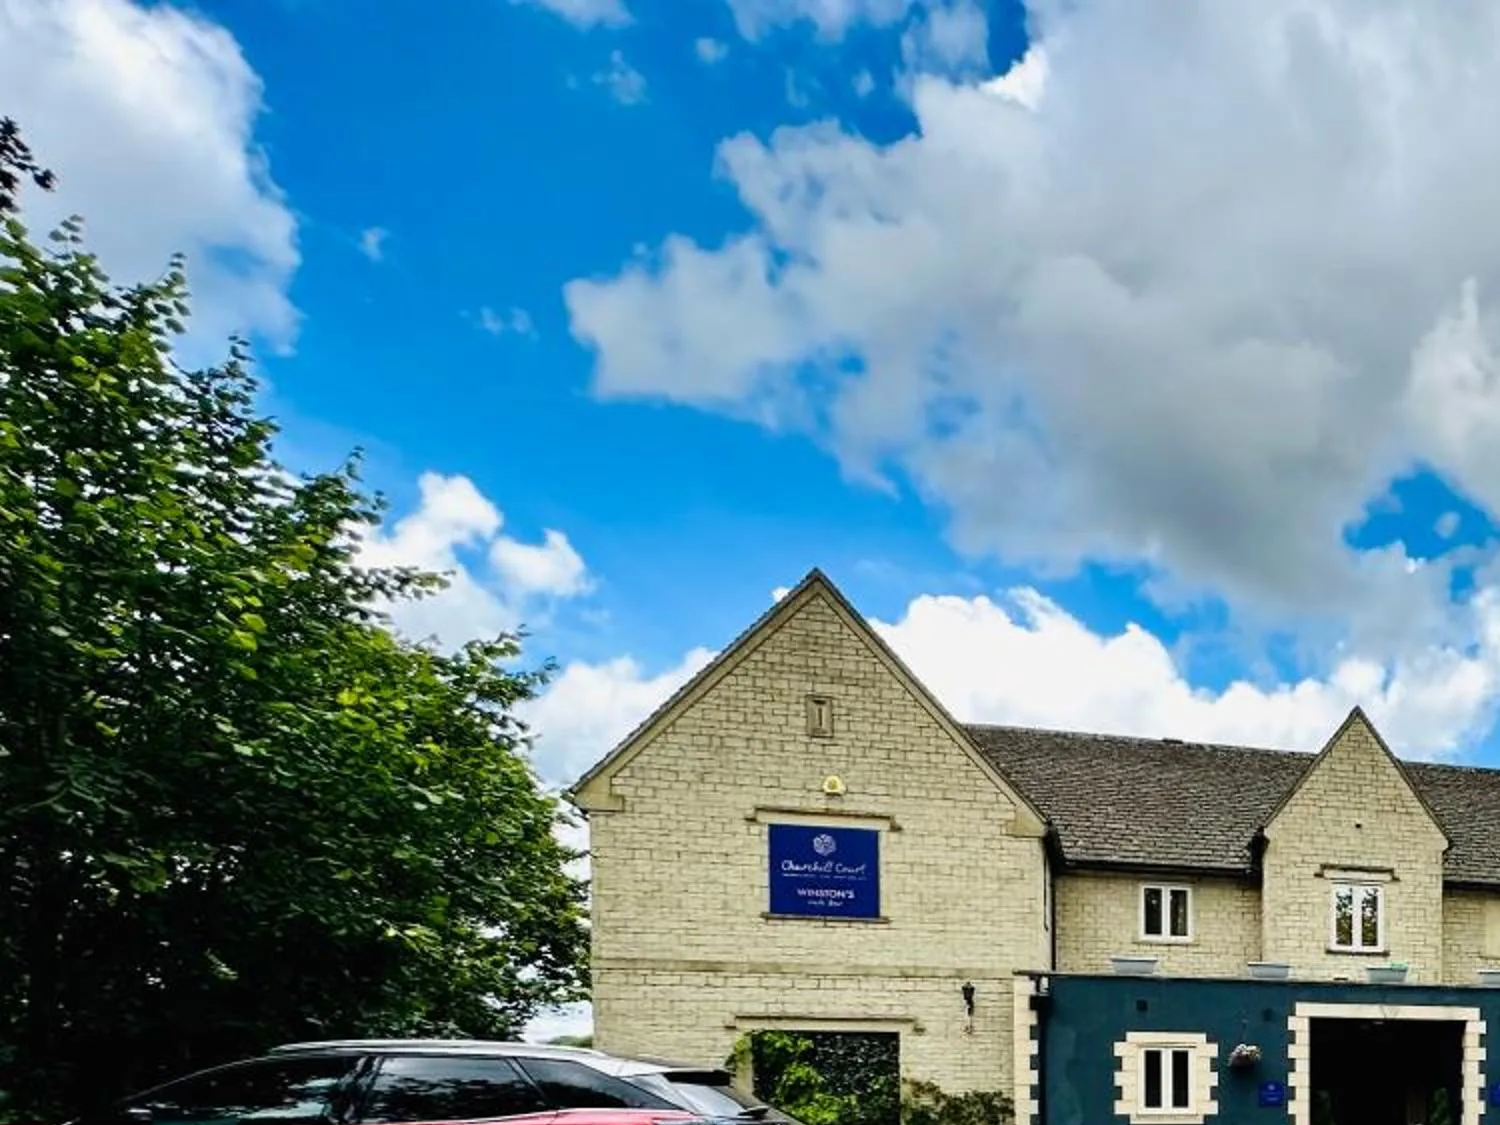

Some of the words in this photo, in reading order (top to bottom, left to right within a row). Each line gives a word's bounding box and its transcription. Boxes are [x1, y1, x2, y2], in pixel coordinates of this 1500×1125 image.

[781, 860, 832, 872] Churchill
[835, 863, 867, 874] Court
[797, 888, 855, 899] WINSTON'S
